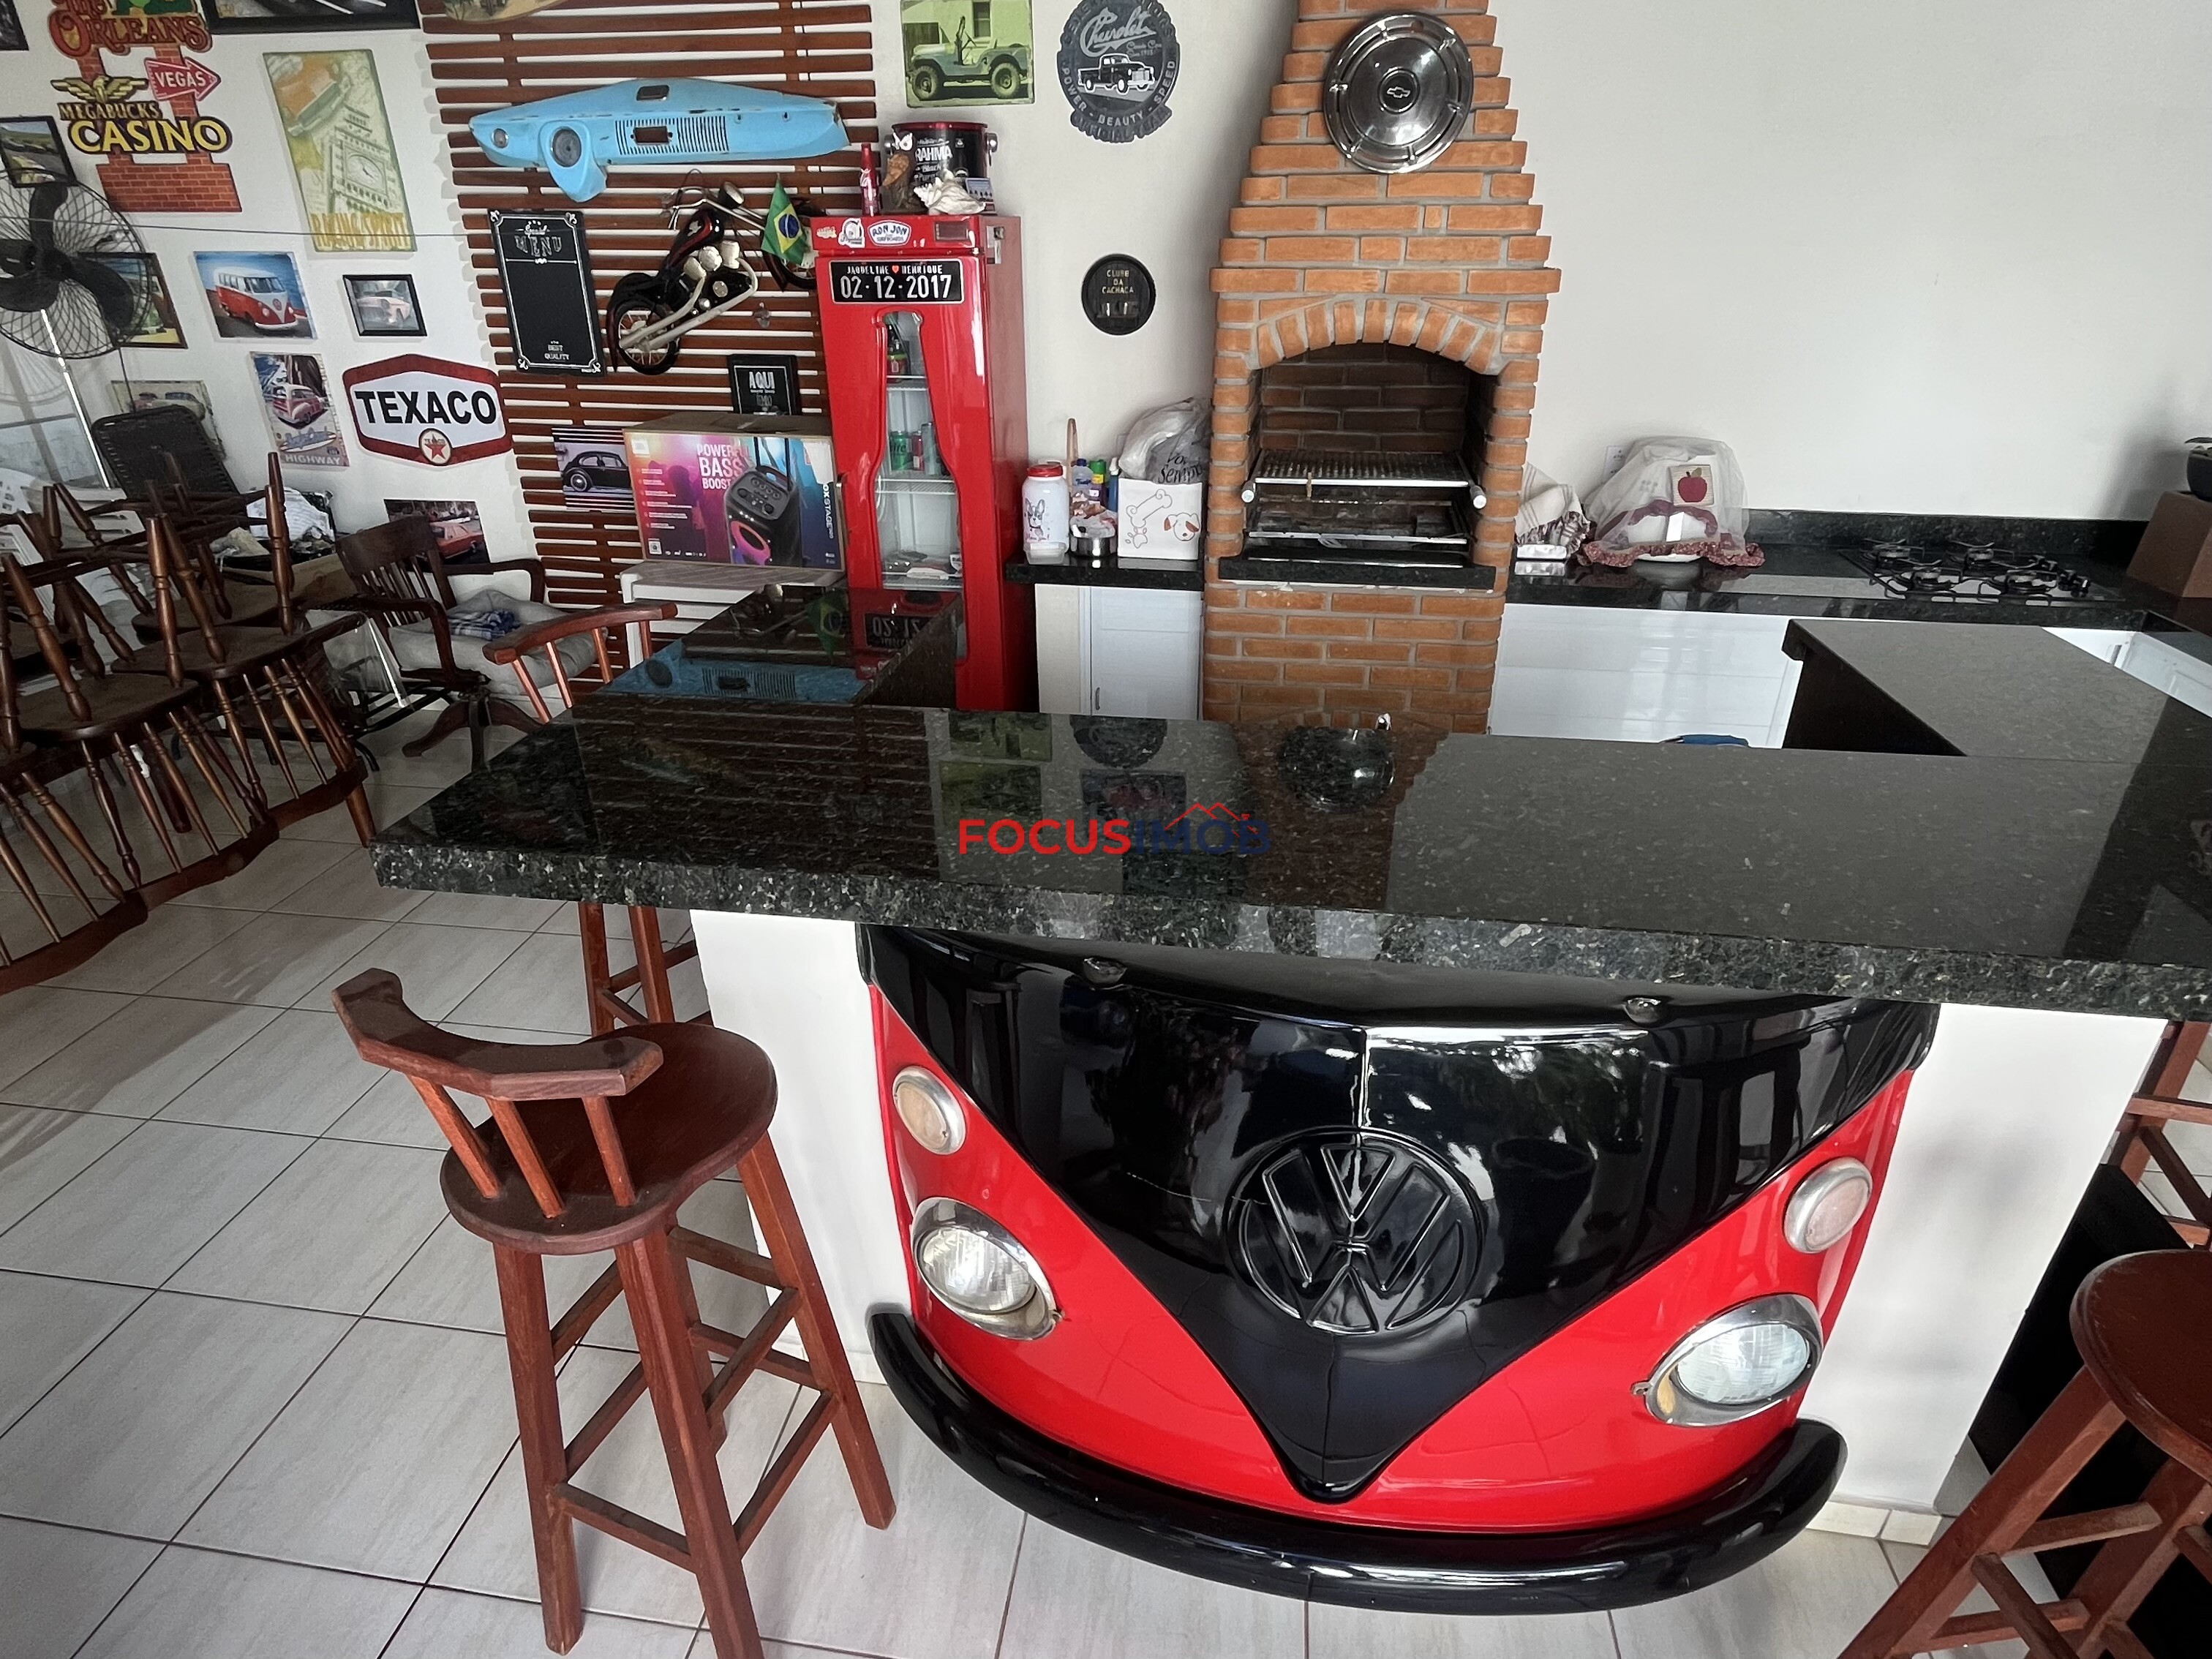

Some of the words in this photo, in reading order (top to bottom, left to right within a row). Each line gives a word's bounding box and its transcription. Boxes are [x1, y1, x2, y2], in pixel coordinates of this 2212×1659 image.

[48, 10, 212, 57] ORLEANS
[154, 71, 206, 88] VEGAS
[1062, 67, 1087, 111] POWER
[1098, 110, 1143, 127] BEAUTY
[1154, 61, 1175, 105] SPEED
[59, 102, 162, 120] MEGABUCKS
[70, 120, 227, 152] CASINO
[914, 146, 953, 162] RAHMA
[514, 236, 563, 257] MENU
[748, 372, 775, 389] AQUI
[356, 390, 497, 424] TEXACO
[285, 454, 340, 465] HIGHWAY
[699, 456, 745, 478] BASS
